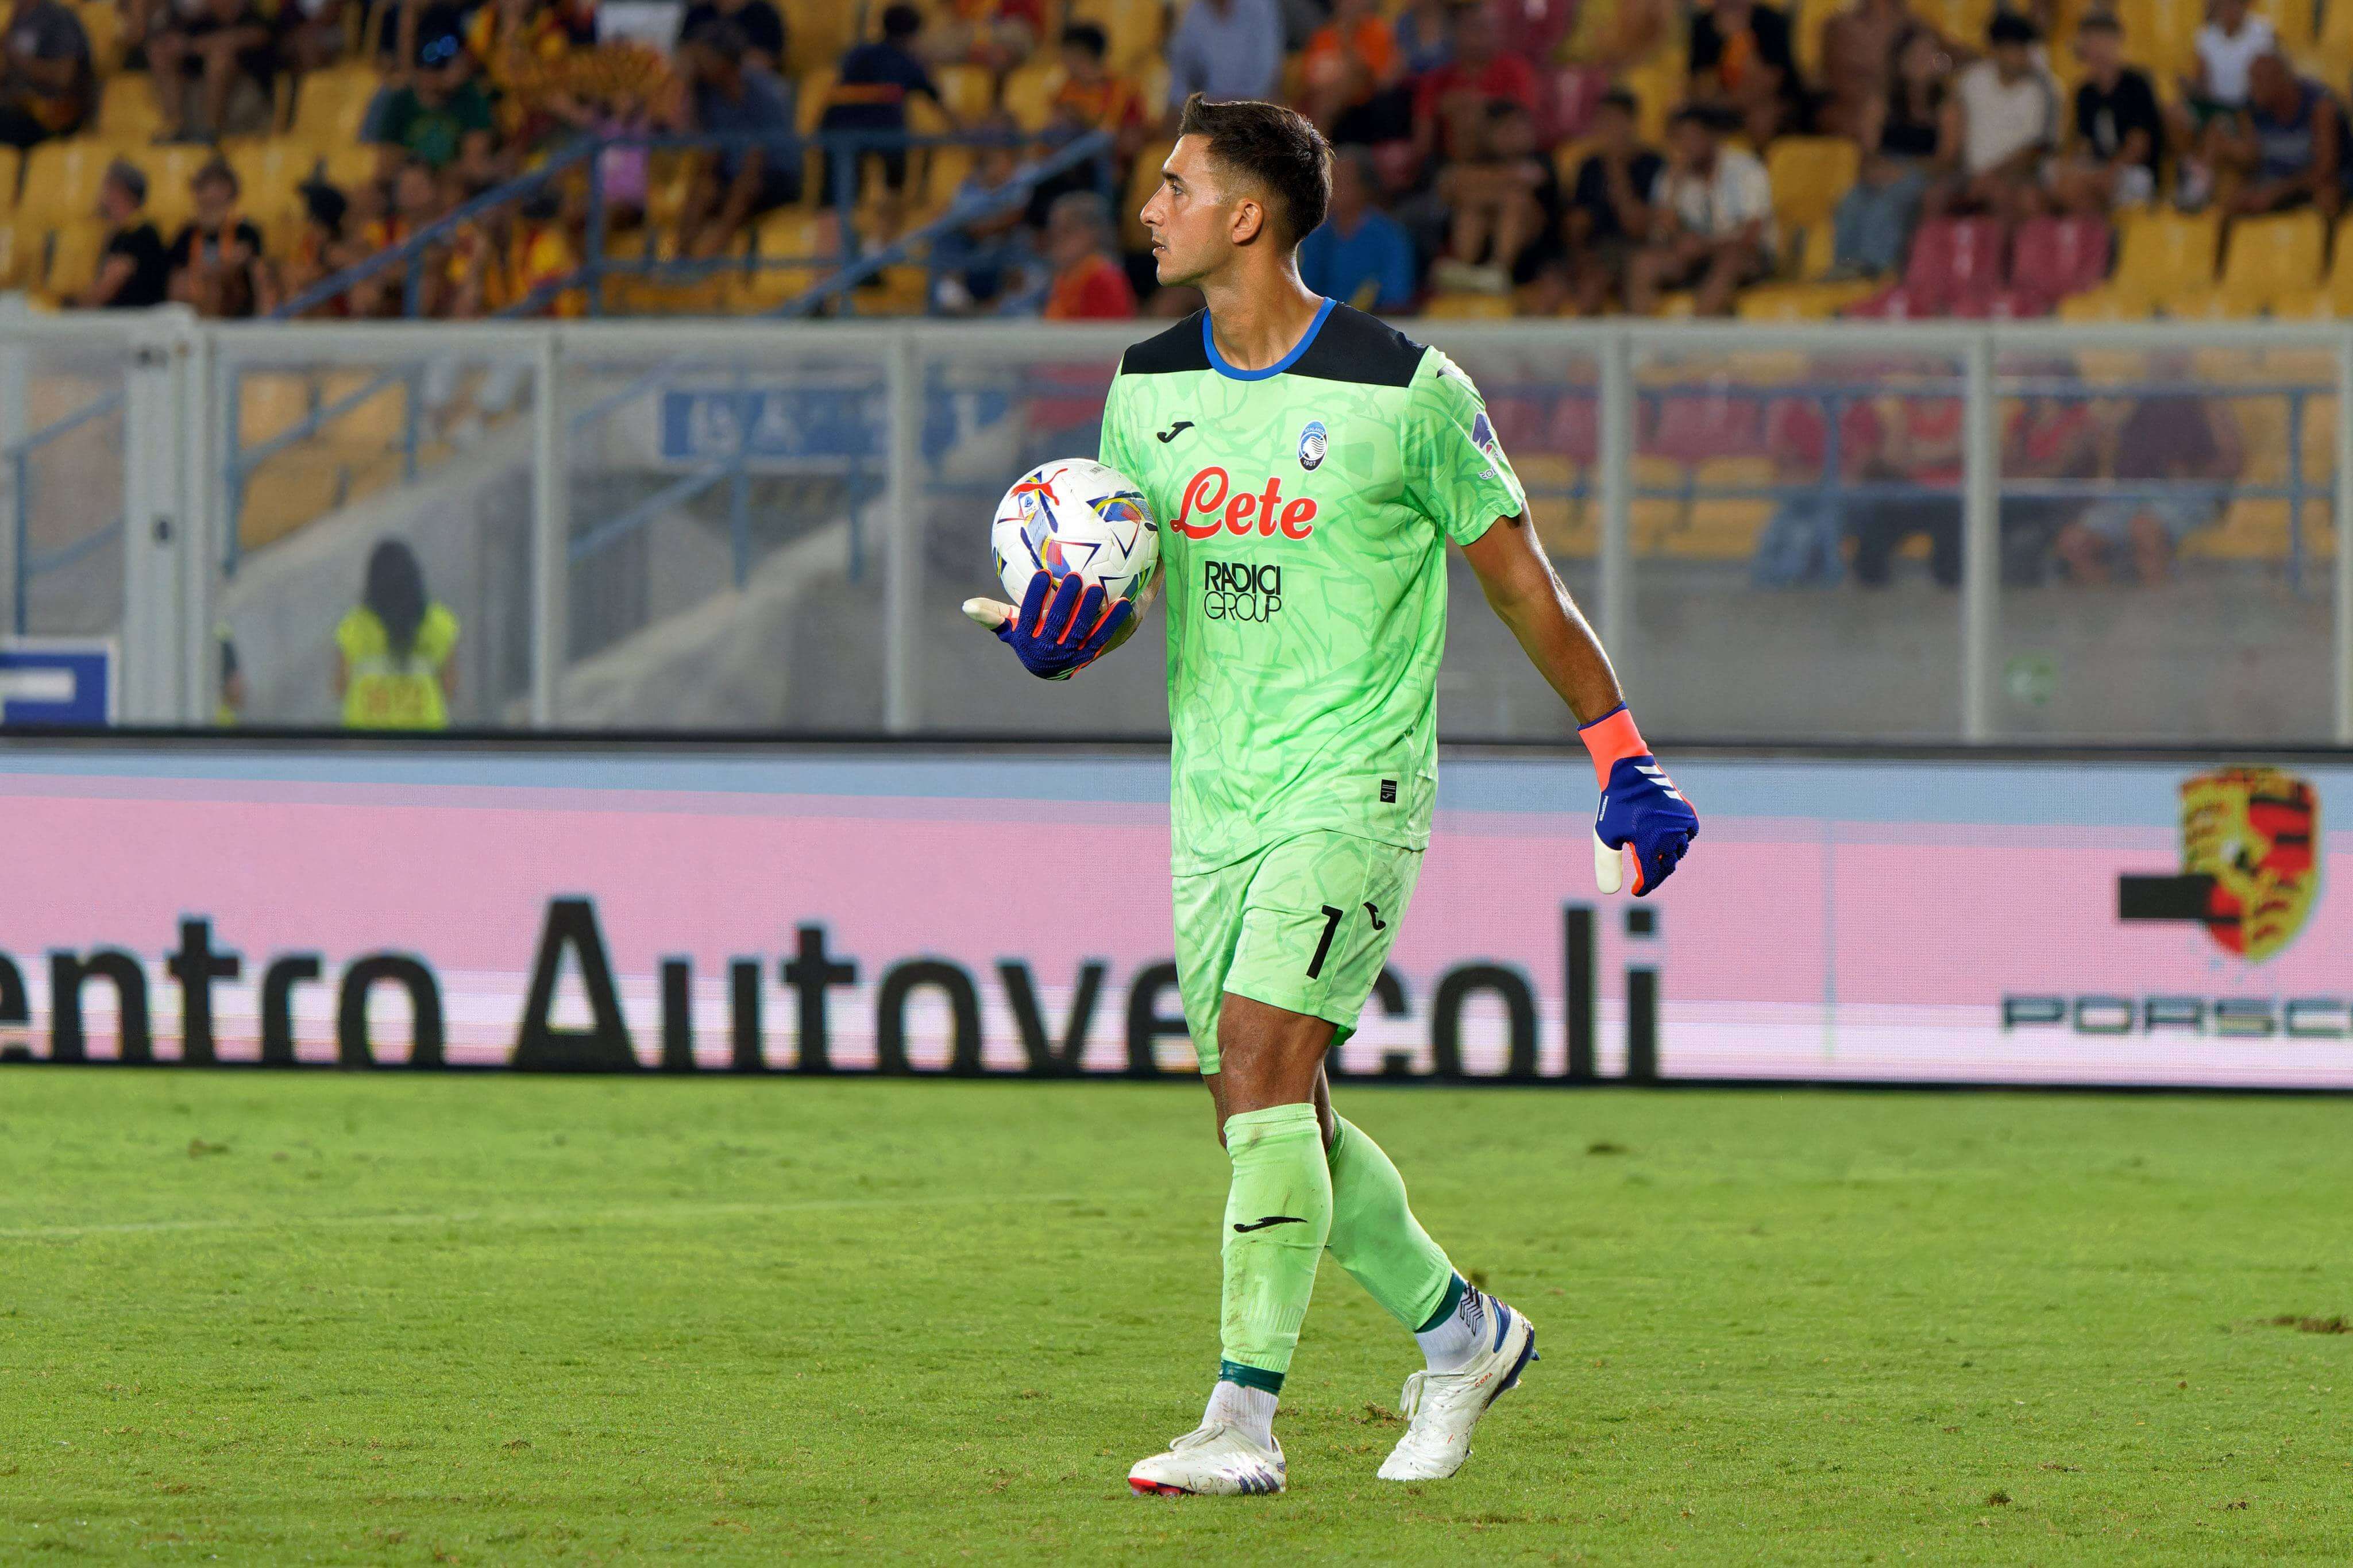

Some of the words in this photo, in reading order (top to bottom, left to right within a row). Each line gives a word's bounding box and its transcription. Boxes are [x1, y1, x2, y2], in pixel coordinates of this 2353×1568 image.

[1170, 466, 1317, 540] Lete
[1204, 561, 1280, 595] RADICI
[1204, 591, 1281, 623] GROUP
[1306, 905, 1343, 980] 1
[2003, 997, 2353, 1037] PORSC
[1475, 1372, 1492, 1388] COPA
